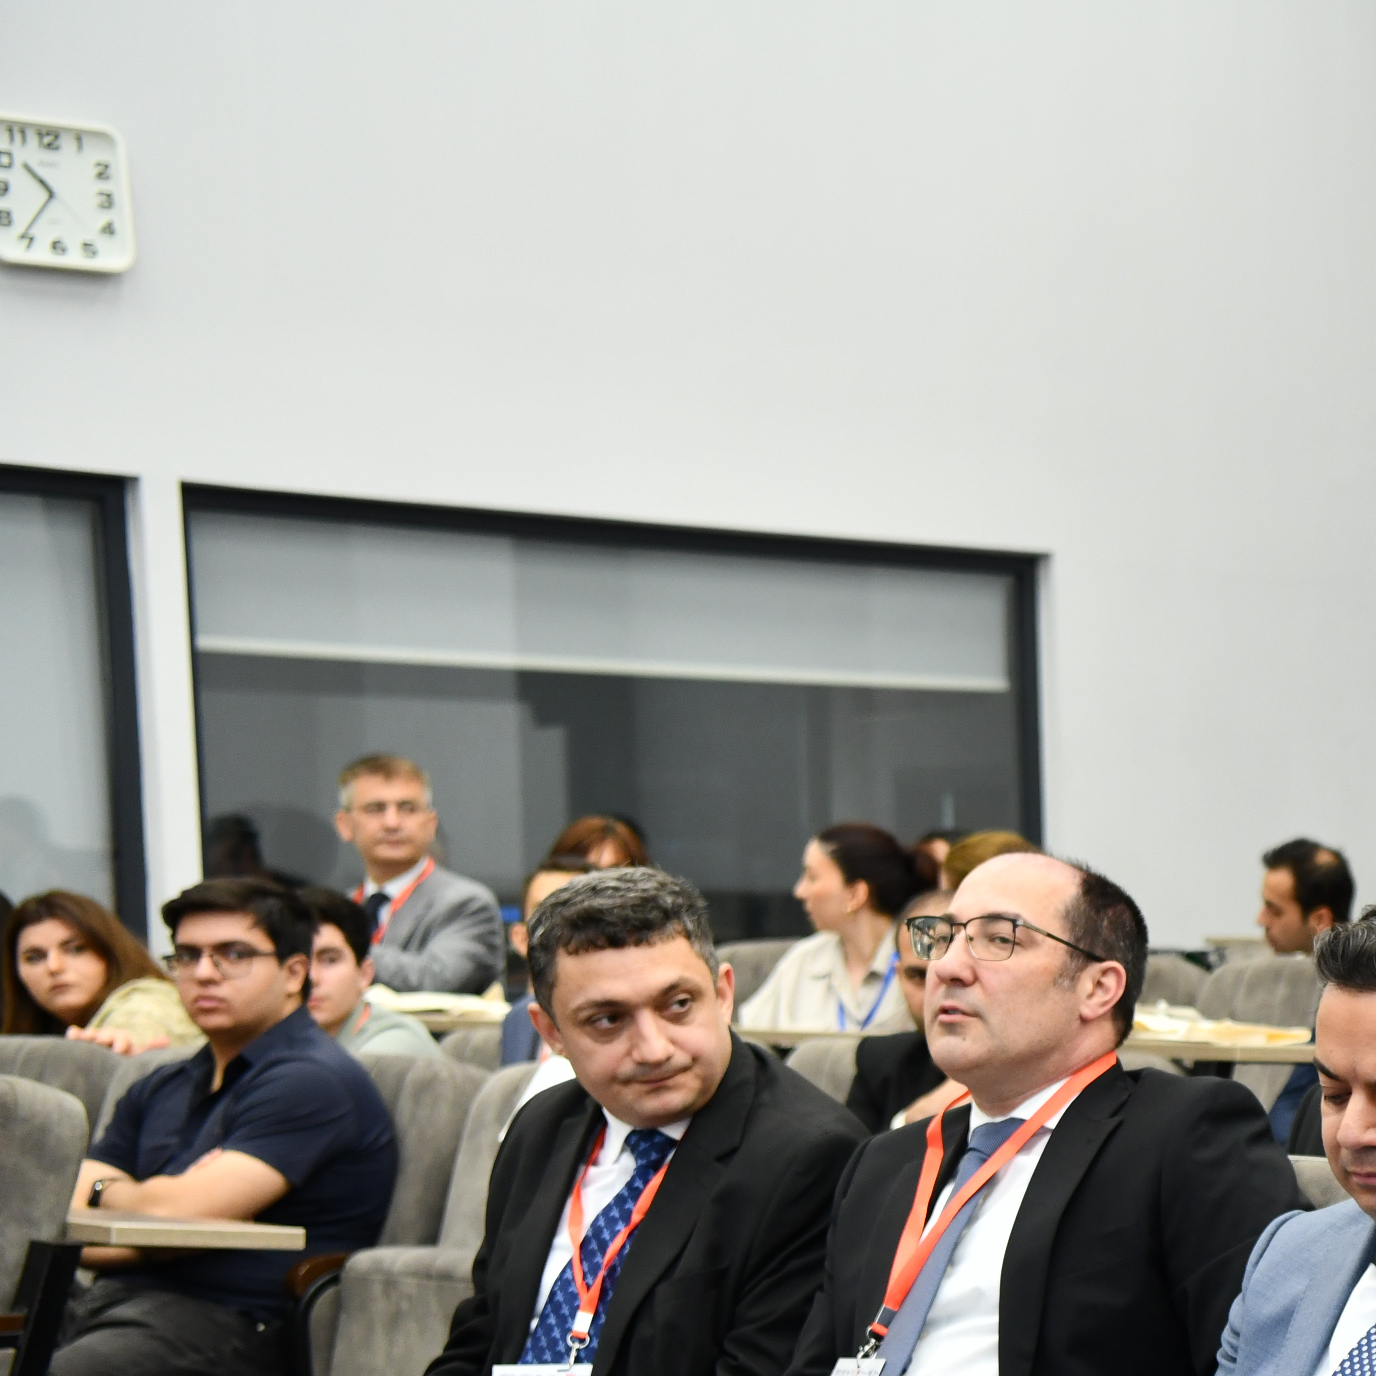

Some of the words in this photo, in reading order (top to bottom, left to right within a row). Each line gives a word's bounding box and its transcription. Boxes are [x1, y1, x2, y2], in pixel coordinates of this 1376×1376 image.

[6, 125, 26, 146] 11
[36, 129, 61, 151] 12
[74, 133, 83, 153] 1
[94, 160, 111, 180] 2
[96, 189, 115, 209] 3
[99, 219, 116, 236] 4
[18, 232, 34, 251] 7
[50, 239, 68, 256] 6
[81, 241, 98, 259] 5
